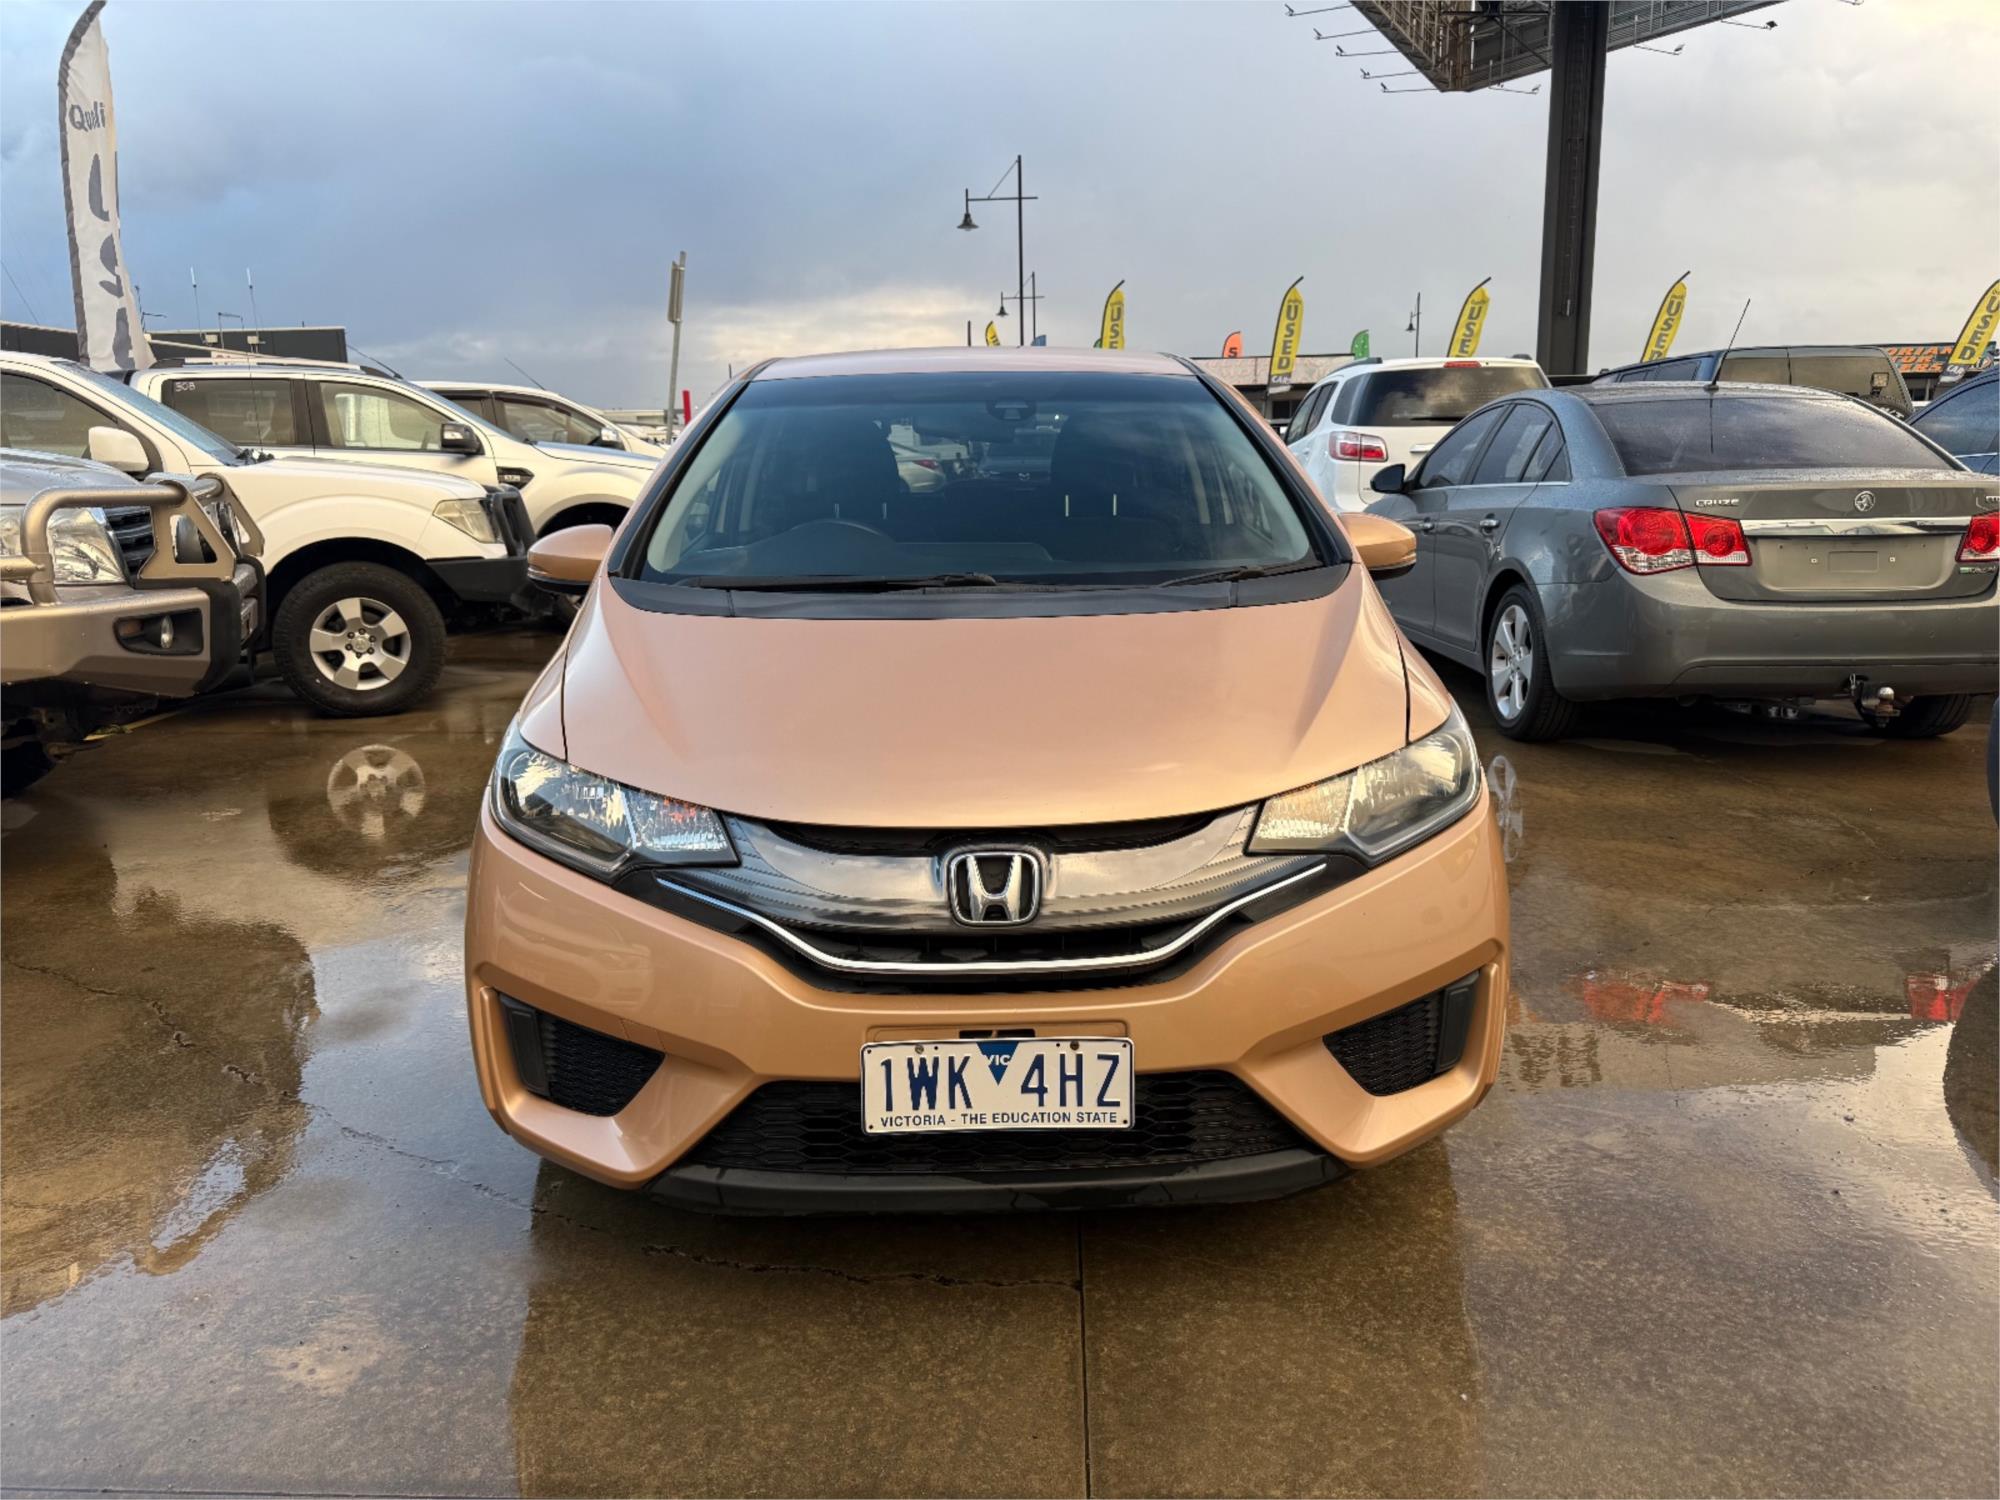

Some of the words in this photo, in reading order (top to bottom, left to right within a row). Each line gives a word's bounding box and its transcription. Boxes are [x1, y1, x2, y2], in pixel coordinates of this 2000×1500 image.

[1277, 304, 1299, 370] USED
[1455, 306, 1482, 357] USE
[1695, 499, 1740, 507] CRUZE
[985, 1054, 1011, 1066] VIC
[880, 1055, 972, 1112] 1WK
[1020, 1053, 1121, 1107] 4HZ
[880, 1114, 945, 1127] VICTORIA
[961, 1113, 987, 1125] THE
[992, 1111, 1071, 1124] EDUCATION
[1076, 1111, 1117, 1123] STATE
